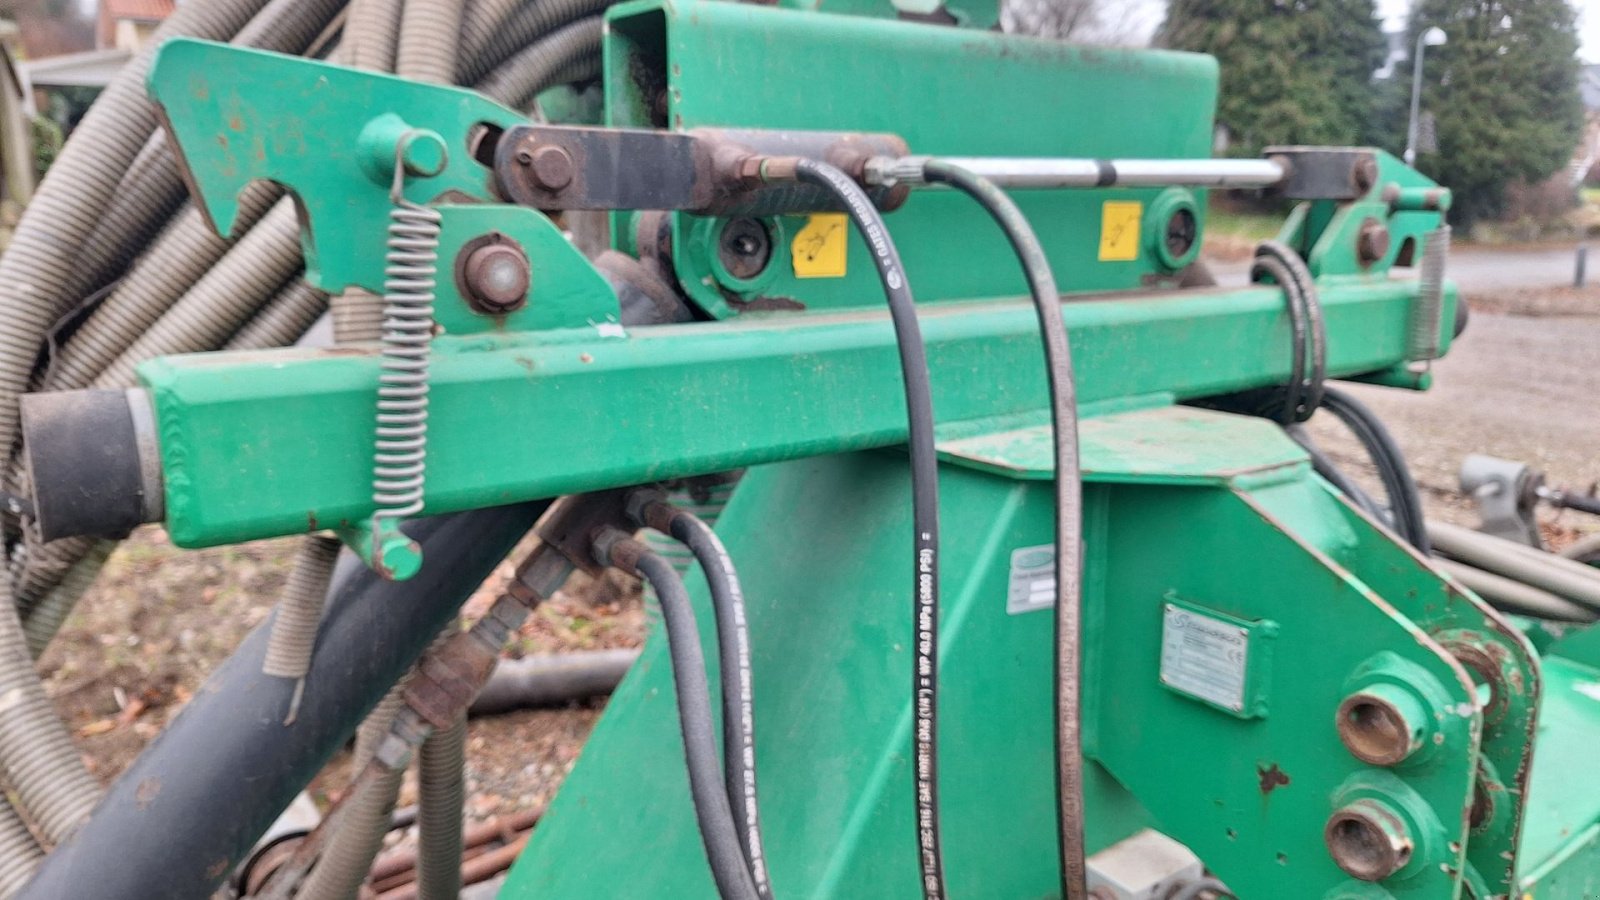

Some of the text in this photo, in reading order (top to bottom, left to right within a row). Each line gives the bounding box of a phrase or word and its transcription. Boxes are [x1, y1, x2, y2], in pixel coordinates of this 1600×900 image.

[867, 224, 888, 257] GATES
[919, 549, 934, 572] PSI)
[919, 606, 932, 630] MPa
[919, 631, 933, 656] 40.0
[919, 656, 931, 676] WP
[919, 781, 932, 802] SAE
